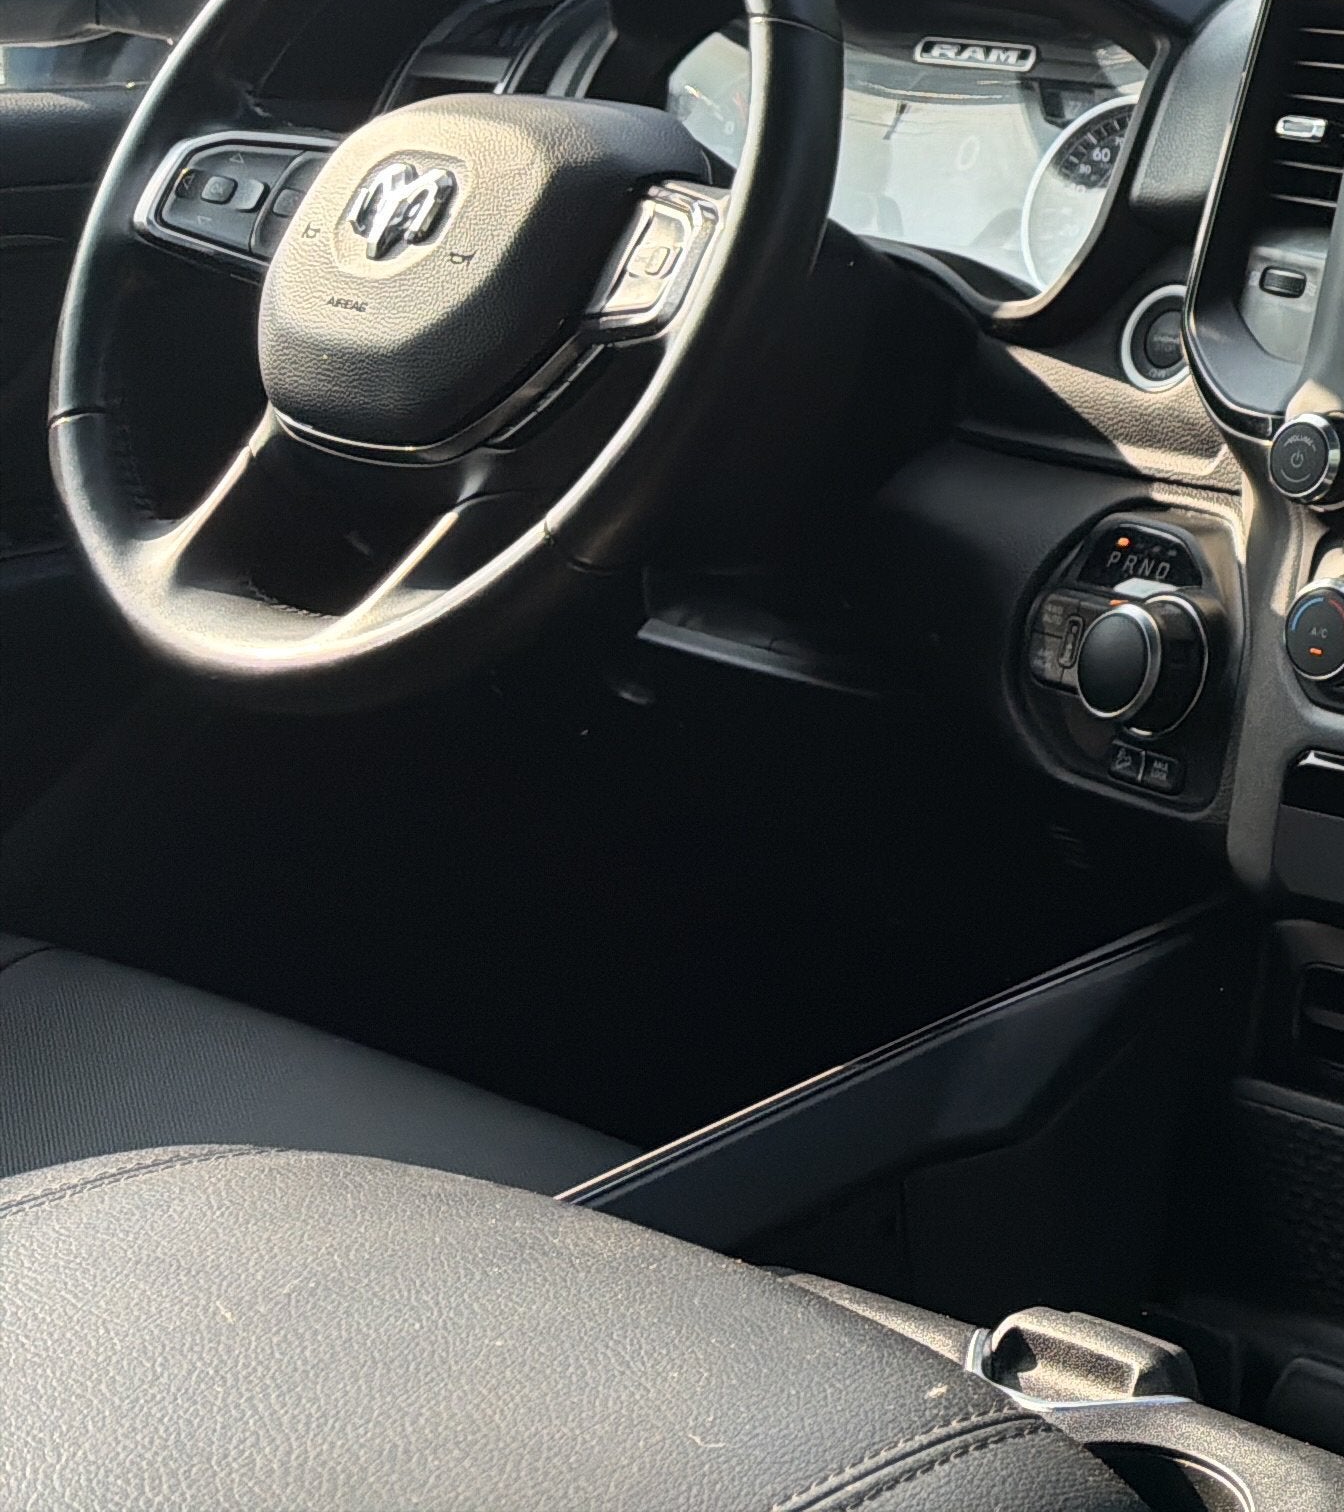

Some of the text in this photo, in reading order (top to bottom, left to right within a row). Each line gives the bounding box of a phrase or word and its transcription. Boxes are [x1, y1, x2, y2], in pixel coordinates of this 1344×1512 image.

[930, 43, 1021, 64] RAM
[1092, 147, 1111, 162] 60
[1106, 551, 1121, 567] P
[1122, 554, 1138, 575] R
[1137, 558, 1155, 576] N
[1309, 625, 1328, 639] A/C
